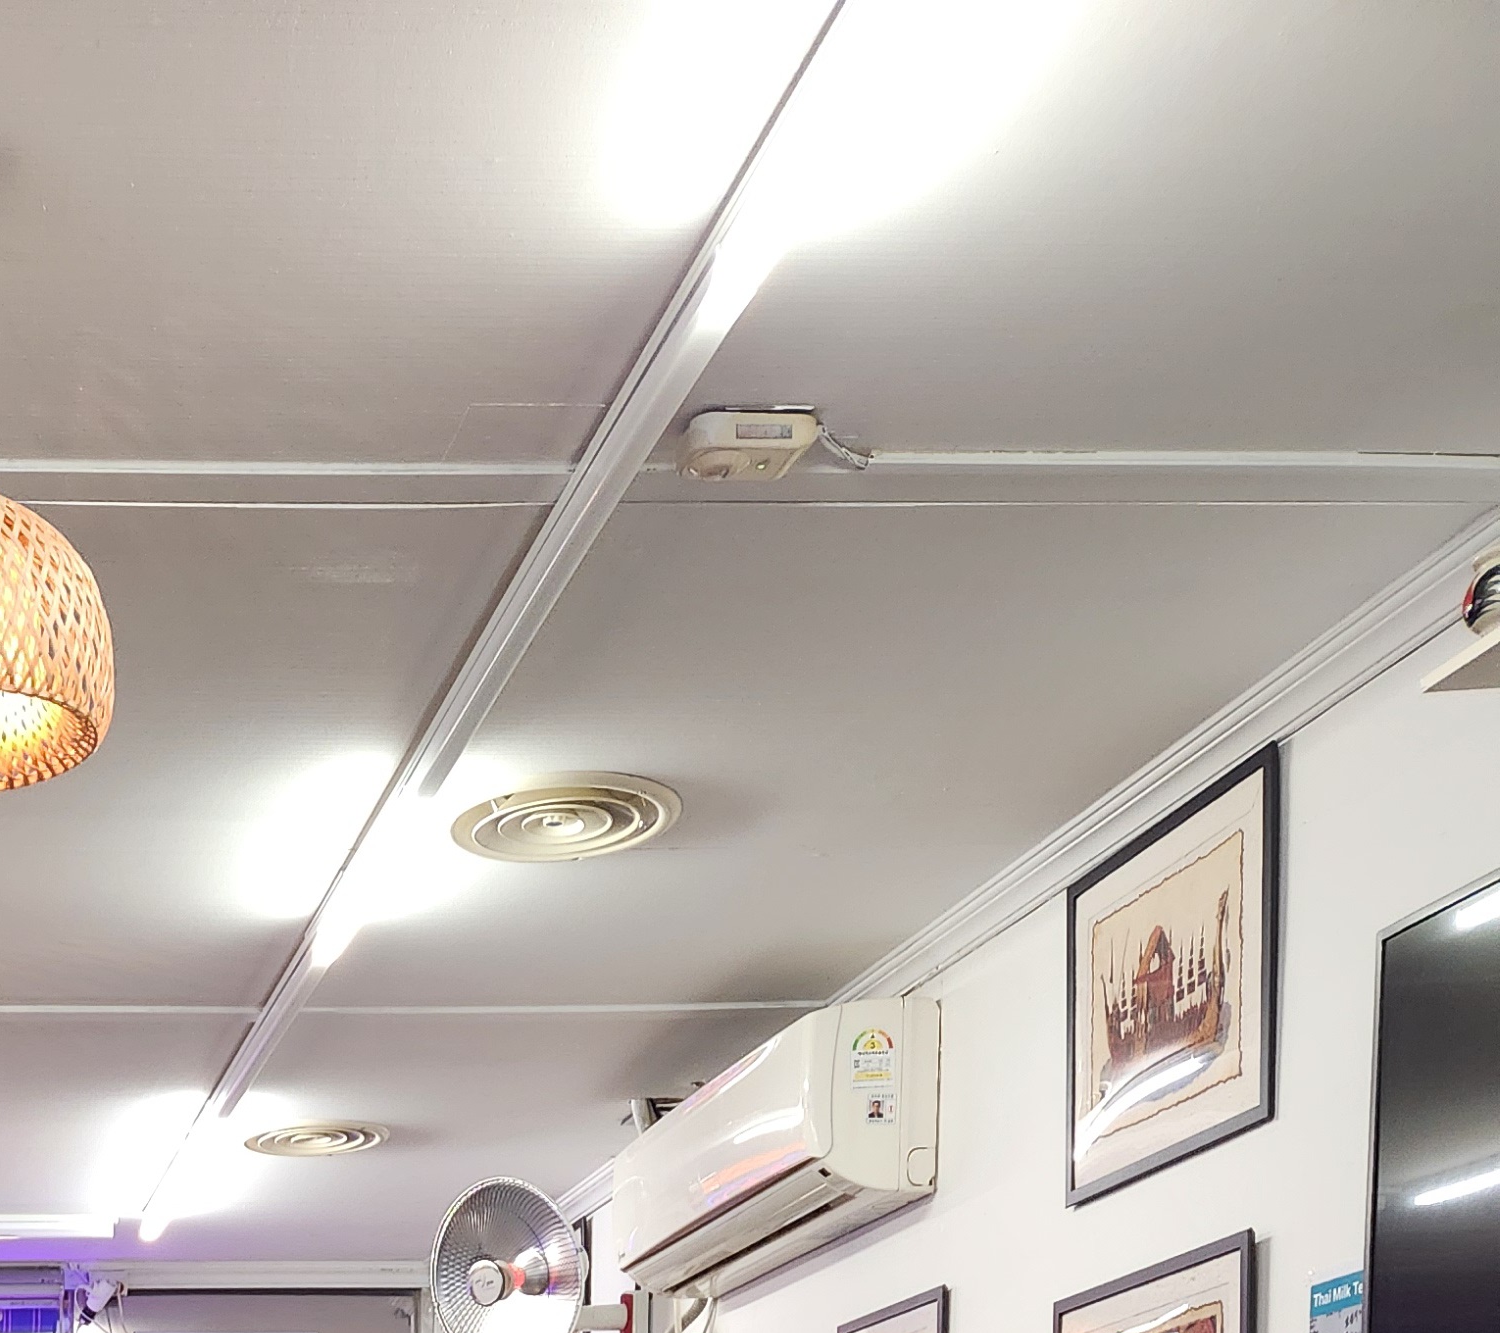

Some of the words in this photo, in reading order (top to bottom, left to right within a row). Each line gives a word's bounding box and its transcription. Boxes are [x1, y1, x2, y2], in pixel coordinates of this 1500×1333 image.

[1313, 1289, 1331, 1307] Thai
[1333, 1283, 1351, 1302] Milk
[1352, 1281, 1363, 1295] Te
